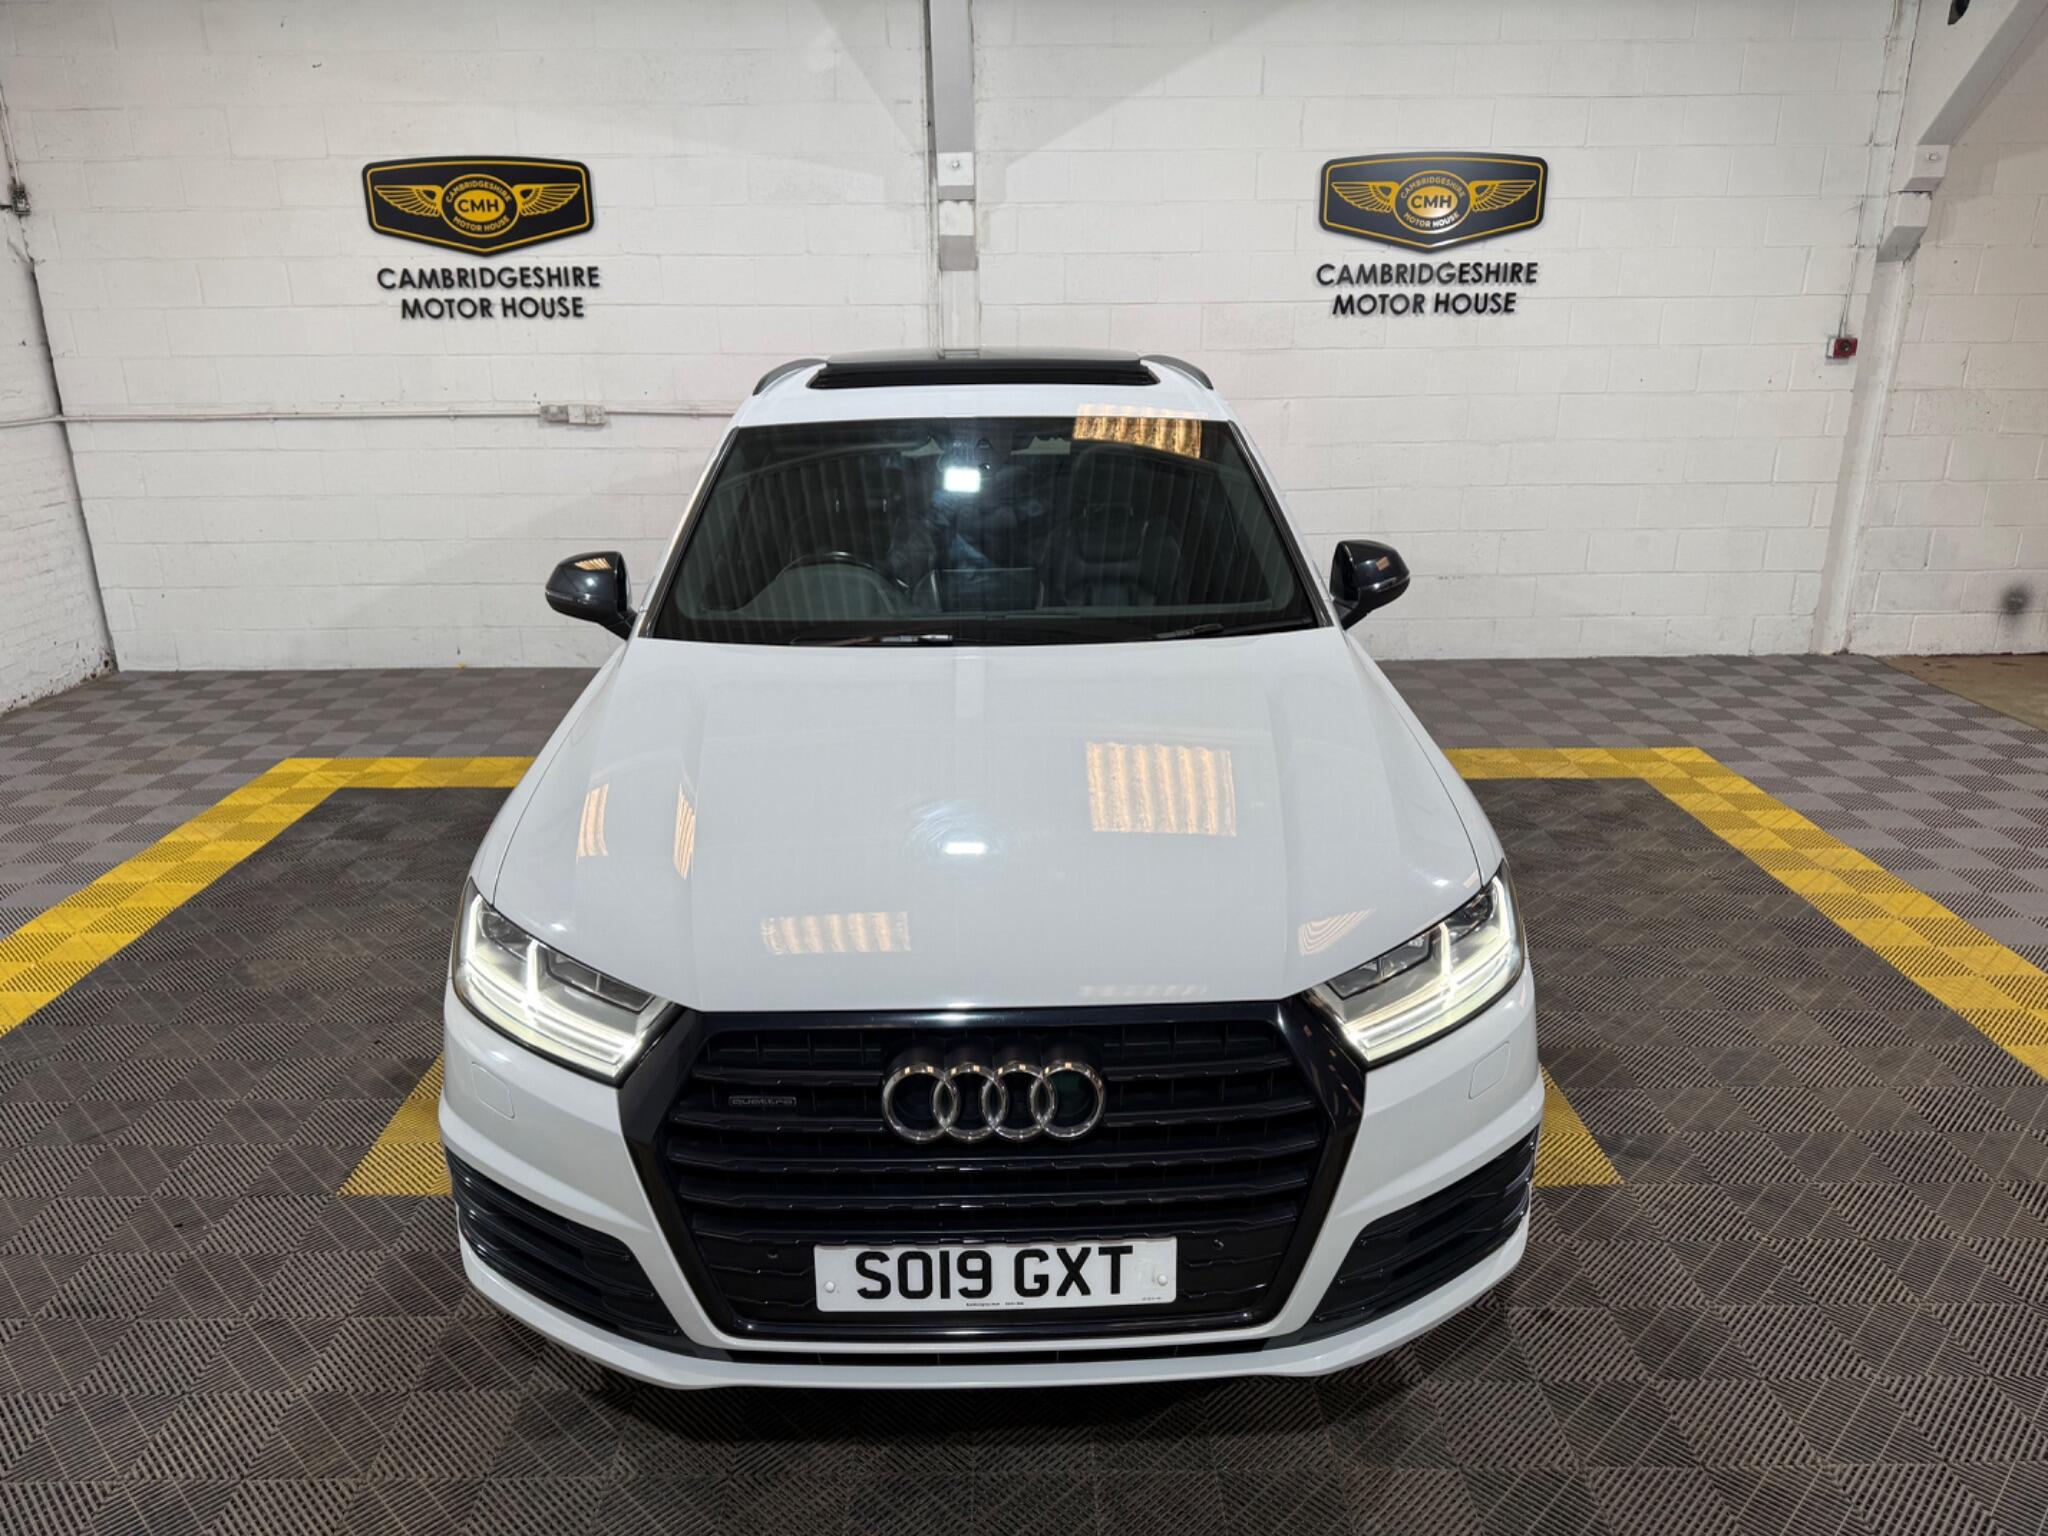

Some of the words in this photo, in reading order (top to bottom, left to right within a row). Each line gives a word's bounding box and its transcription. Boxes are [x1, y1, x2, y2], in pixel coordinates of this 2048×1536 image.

[446, 180, 512, 202] CAMBRIDGESHIRE
[1400, 176, 1467, 199] CAMBRIDGESHIRE
[457, 198, 499, 213] CMH
[1410, 194, 1452, 209] CMH
[452, 215, 483, 232] MOTOR
[484, 215, 511, 232] HOUSE
[1402, 211, 1431, 227] MOTOR
[1432, 211, 1460, 228] HOUSE
[377, 266, 600, 290] CAMBRIDGESHIRE
[1316, 262, 1538, 286] CAMBRIDGESHIRE
[401, 297, 493, 319] MOTOR
[501, 296, 584, 318] HOUSE
[1332, 293, 1425, 315] MOTOR
[1433, 292, 1517, 314] HOUSE
[855, 1249, 993, 1300] SO19
[1013, 1245, 1133, 1297] GXT
